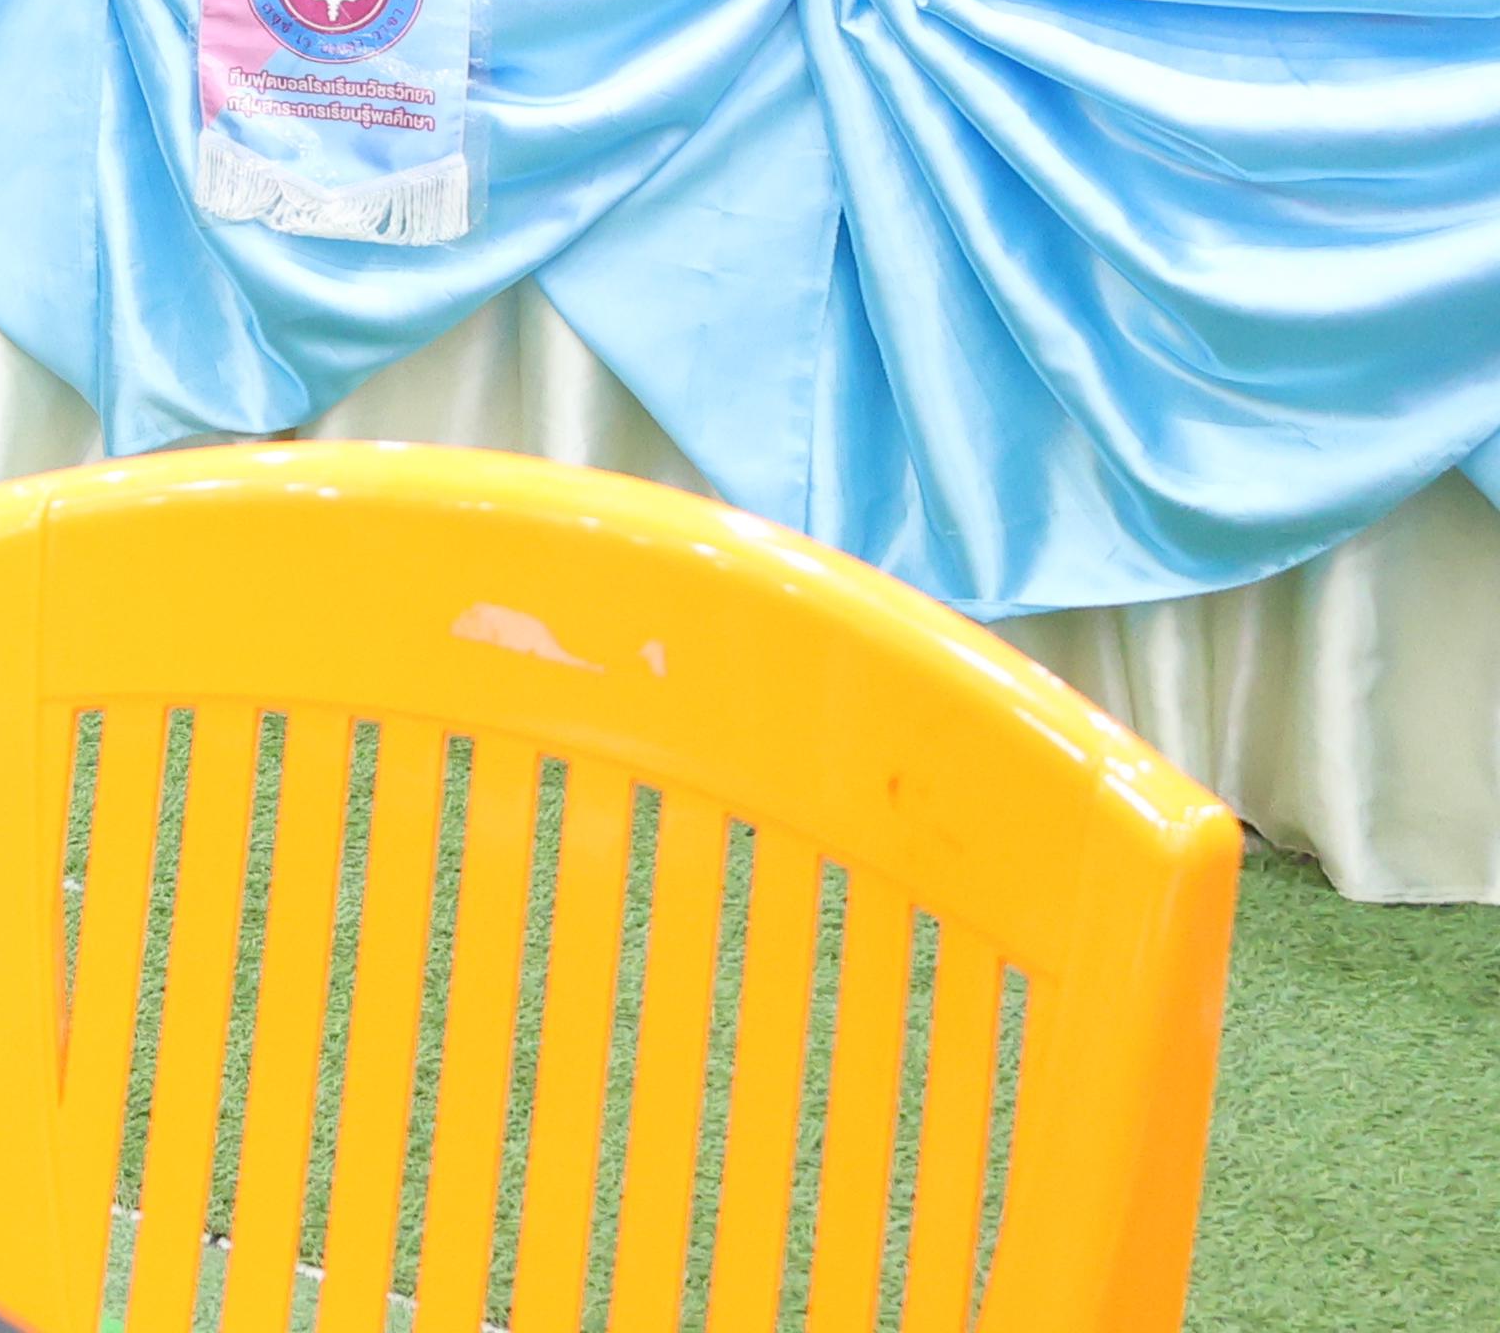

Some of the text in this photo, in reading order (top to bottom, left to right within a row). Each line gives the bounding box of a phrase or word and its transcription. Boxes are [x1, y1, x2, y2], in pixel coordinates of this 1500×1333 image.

[227, 66, 435, 106] ทีมฟุตบอลโรงเรียนวัชรวิทยา
[227, 94, 436, 131] กลุ่มสาระการเรียนรู้พลศึกษา
